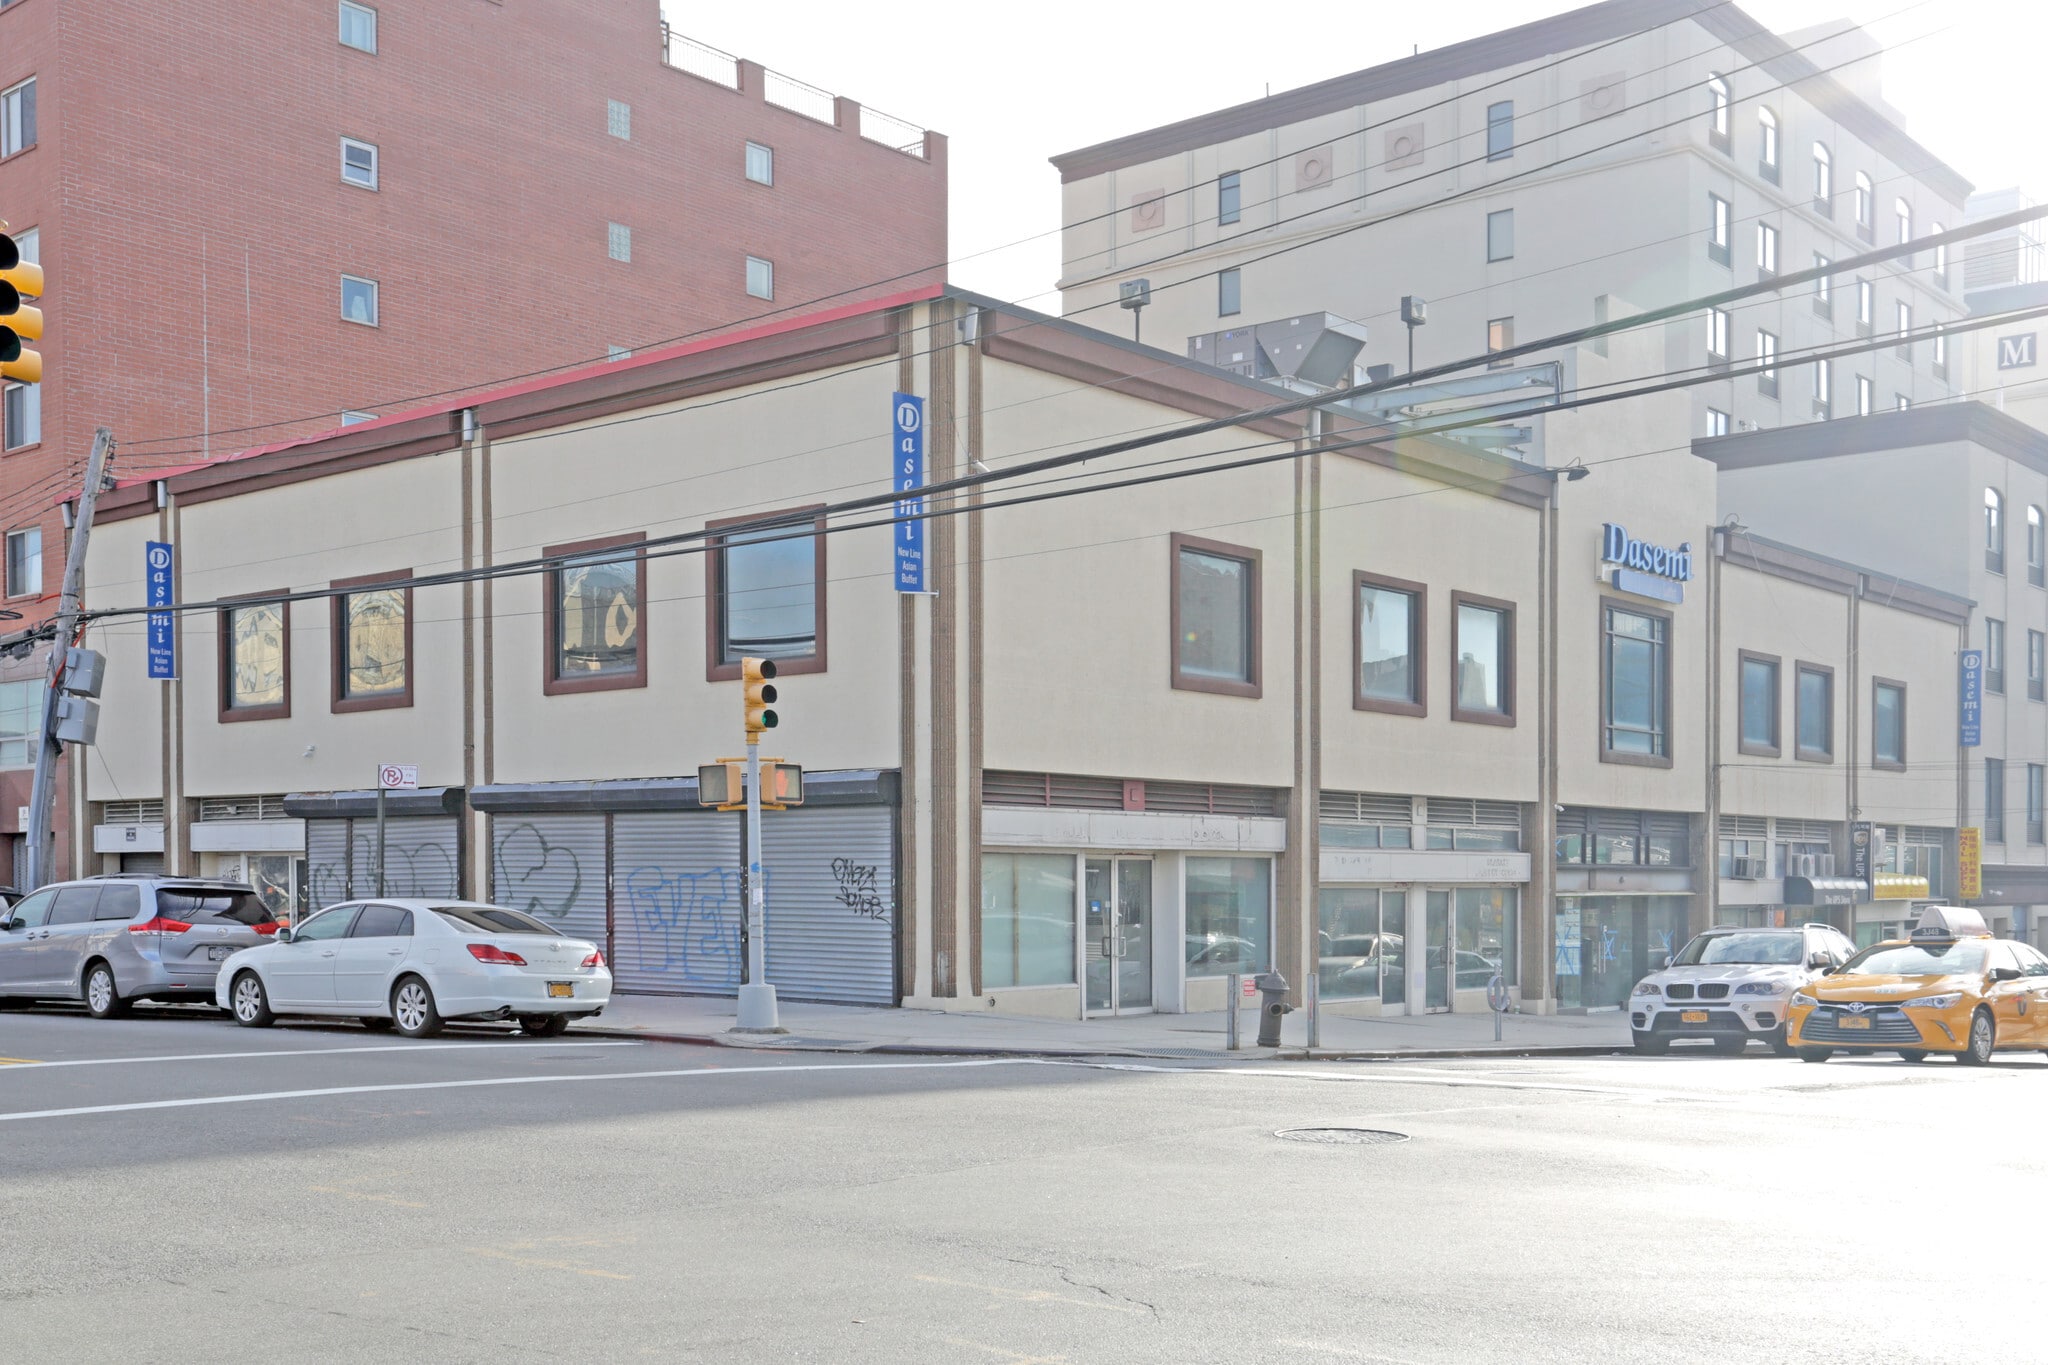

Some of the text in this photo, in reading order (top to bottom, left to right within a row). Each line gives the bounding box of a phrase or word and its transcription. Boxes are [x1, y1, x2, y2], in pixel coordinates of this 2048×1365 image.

[2001, 336, 2032, 367] M
[898, 546, 921, 560] New Line
[1601, 522, 1694, 582] Dasemi
[902, 560, 917, 572] Asian
[901, 573, 918, 585] Buffet
[1855, 847, 1866, 862] The
[1855, 863, 1866, 878] UPS
